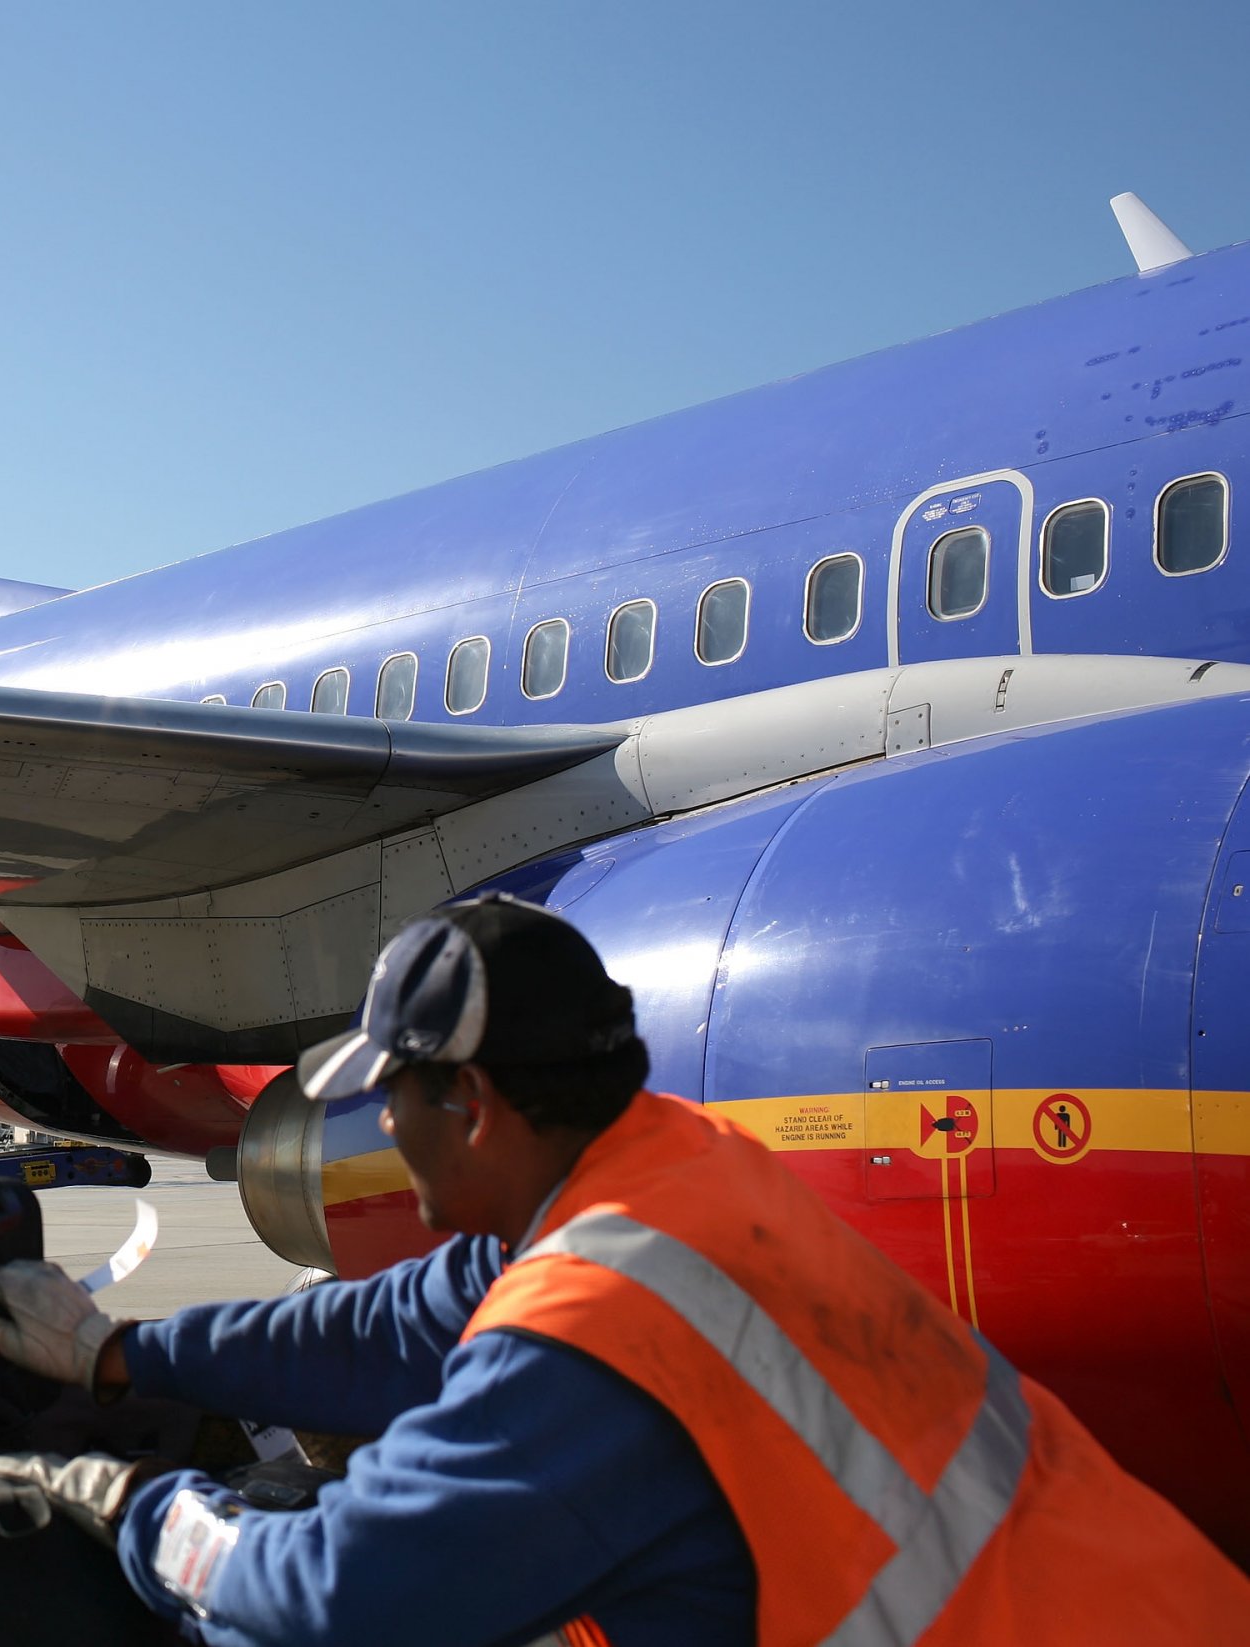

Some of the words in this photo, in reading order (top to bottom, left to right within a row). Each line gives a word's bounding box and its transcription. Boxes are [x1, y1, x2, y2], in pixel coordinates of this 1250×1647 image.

[784, 1116, 807, 1124] STAND
[775, 1124, 803, 1132] HAZARD
[831, 1122, 853, 1130] WHILE
[781, 1133, 806, 1141] ENGINE
[815, 1132, 846, 1140] RUNNING
